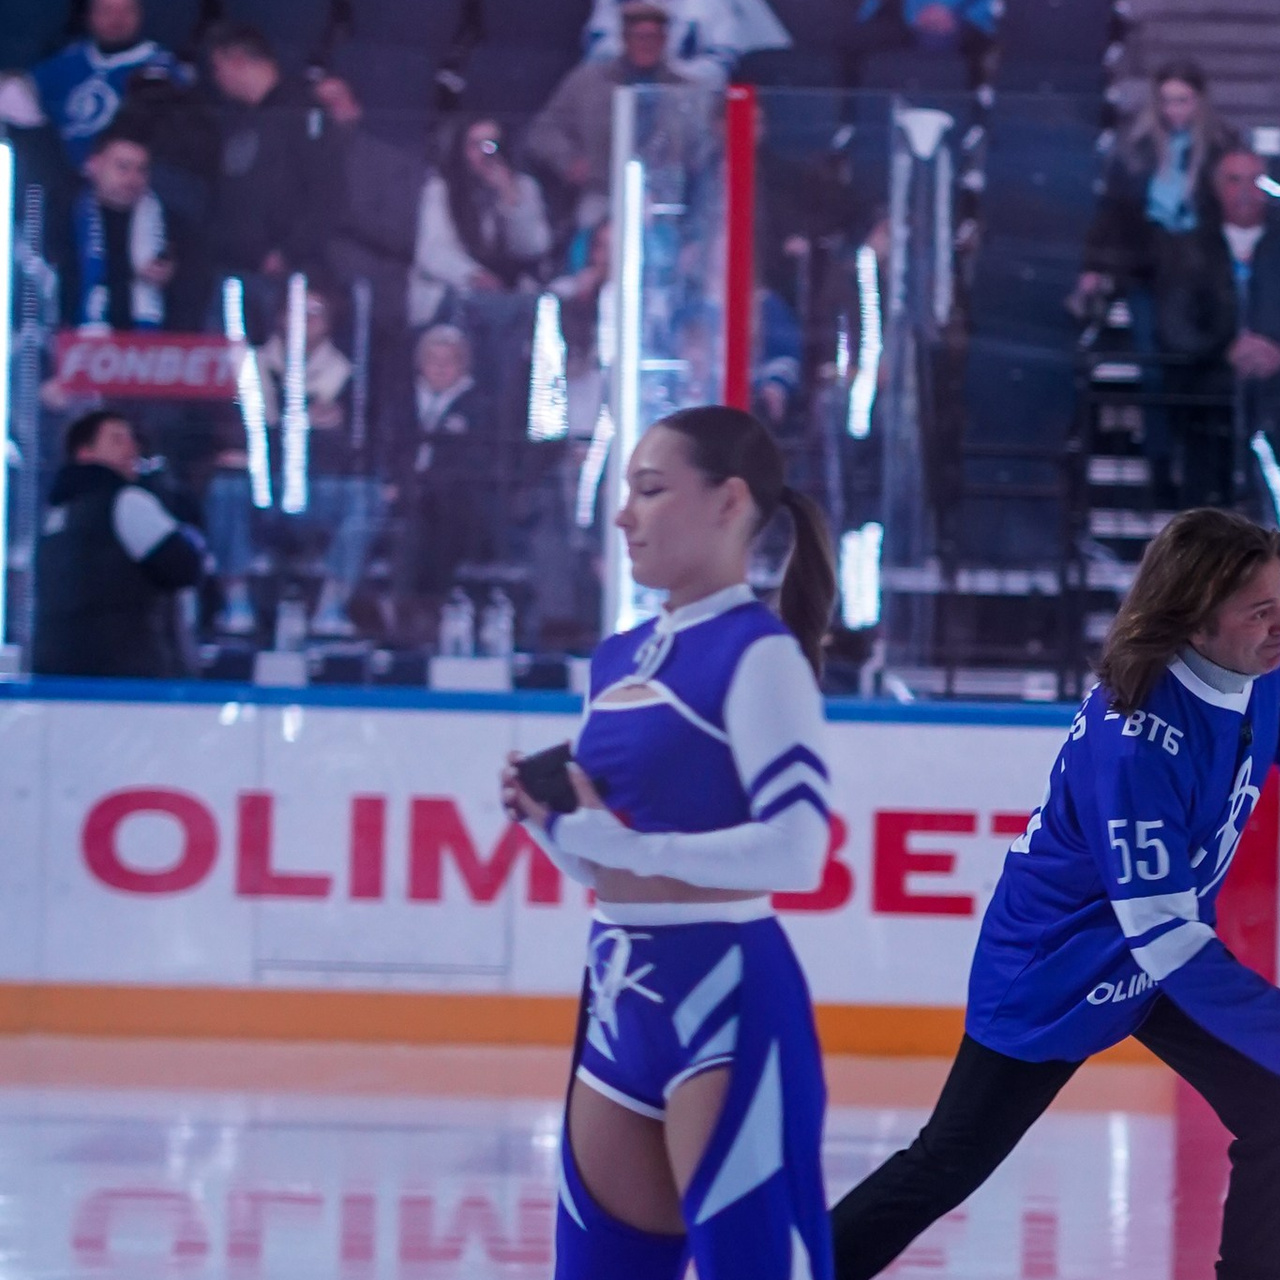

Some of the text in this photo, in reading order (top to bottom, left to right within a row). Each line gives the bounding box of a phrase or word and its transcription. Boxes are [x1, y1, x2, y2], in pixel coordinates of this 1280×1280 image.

[1121, 709, 1184, 756] ВТБ
[1107, 819, 1171, 885] 55
[1086, 971, 1159, 1006] OLIM
